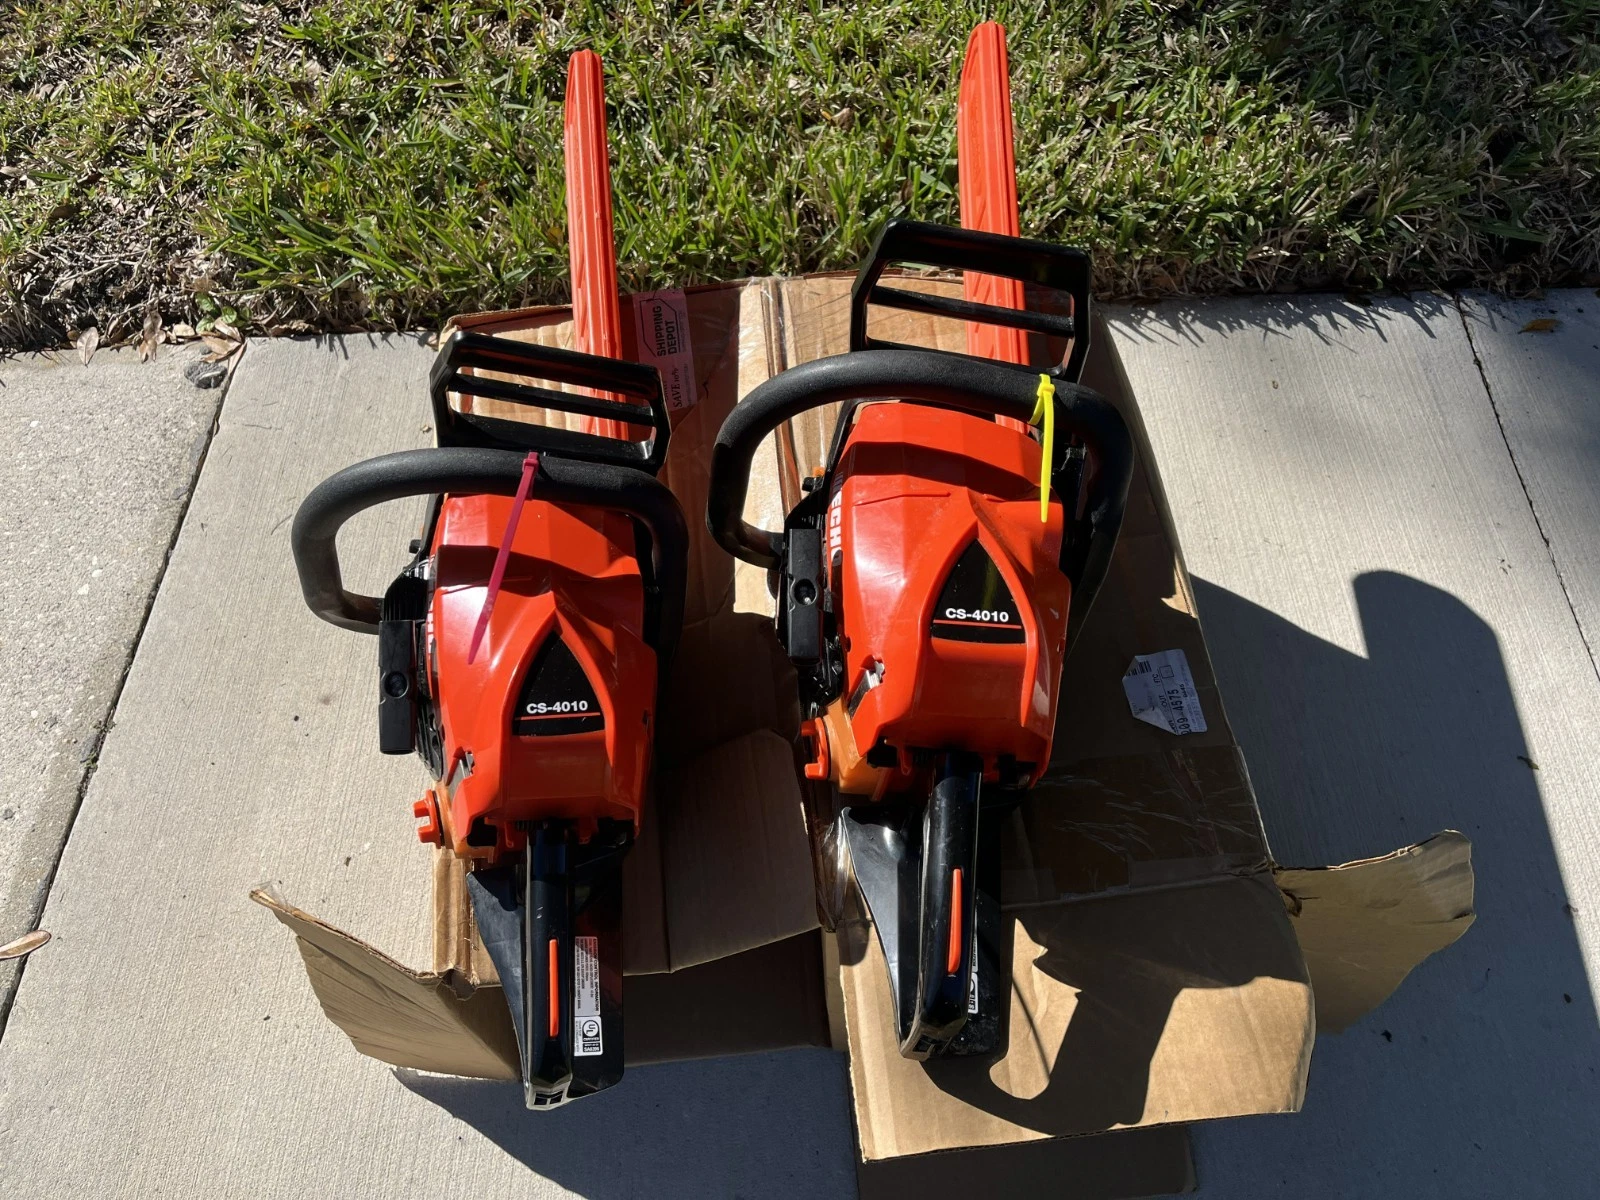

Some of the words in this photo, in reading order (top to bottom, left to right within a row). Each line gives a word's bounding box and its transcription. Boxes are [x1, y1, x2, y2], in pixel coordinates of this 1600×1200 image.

[653, 306, 666, 357] SHIPPING
[665, 321, 677, 355] DEPOT
[671, 384, 682, 407] SAVE
[830, 490, 842, 566] ECHO
[945, 608, 1009, 622] CS-4010
[526, 701, 588, 714] CS-4010
[586, 1024, 596, 1034] UL
